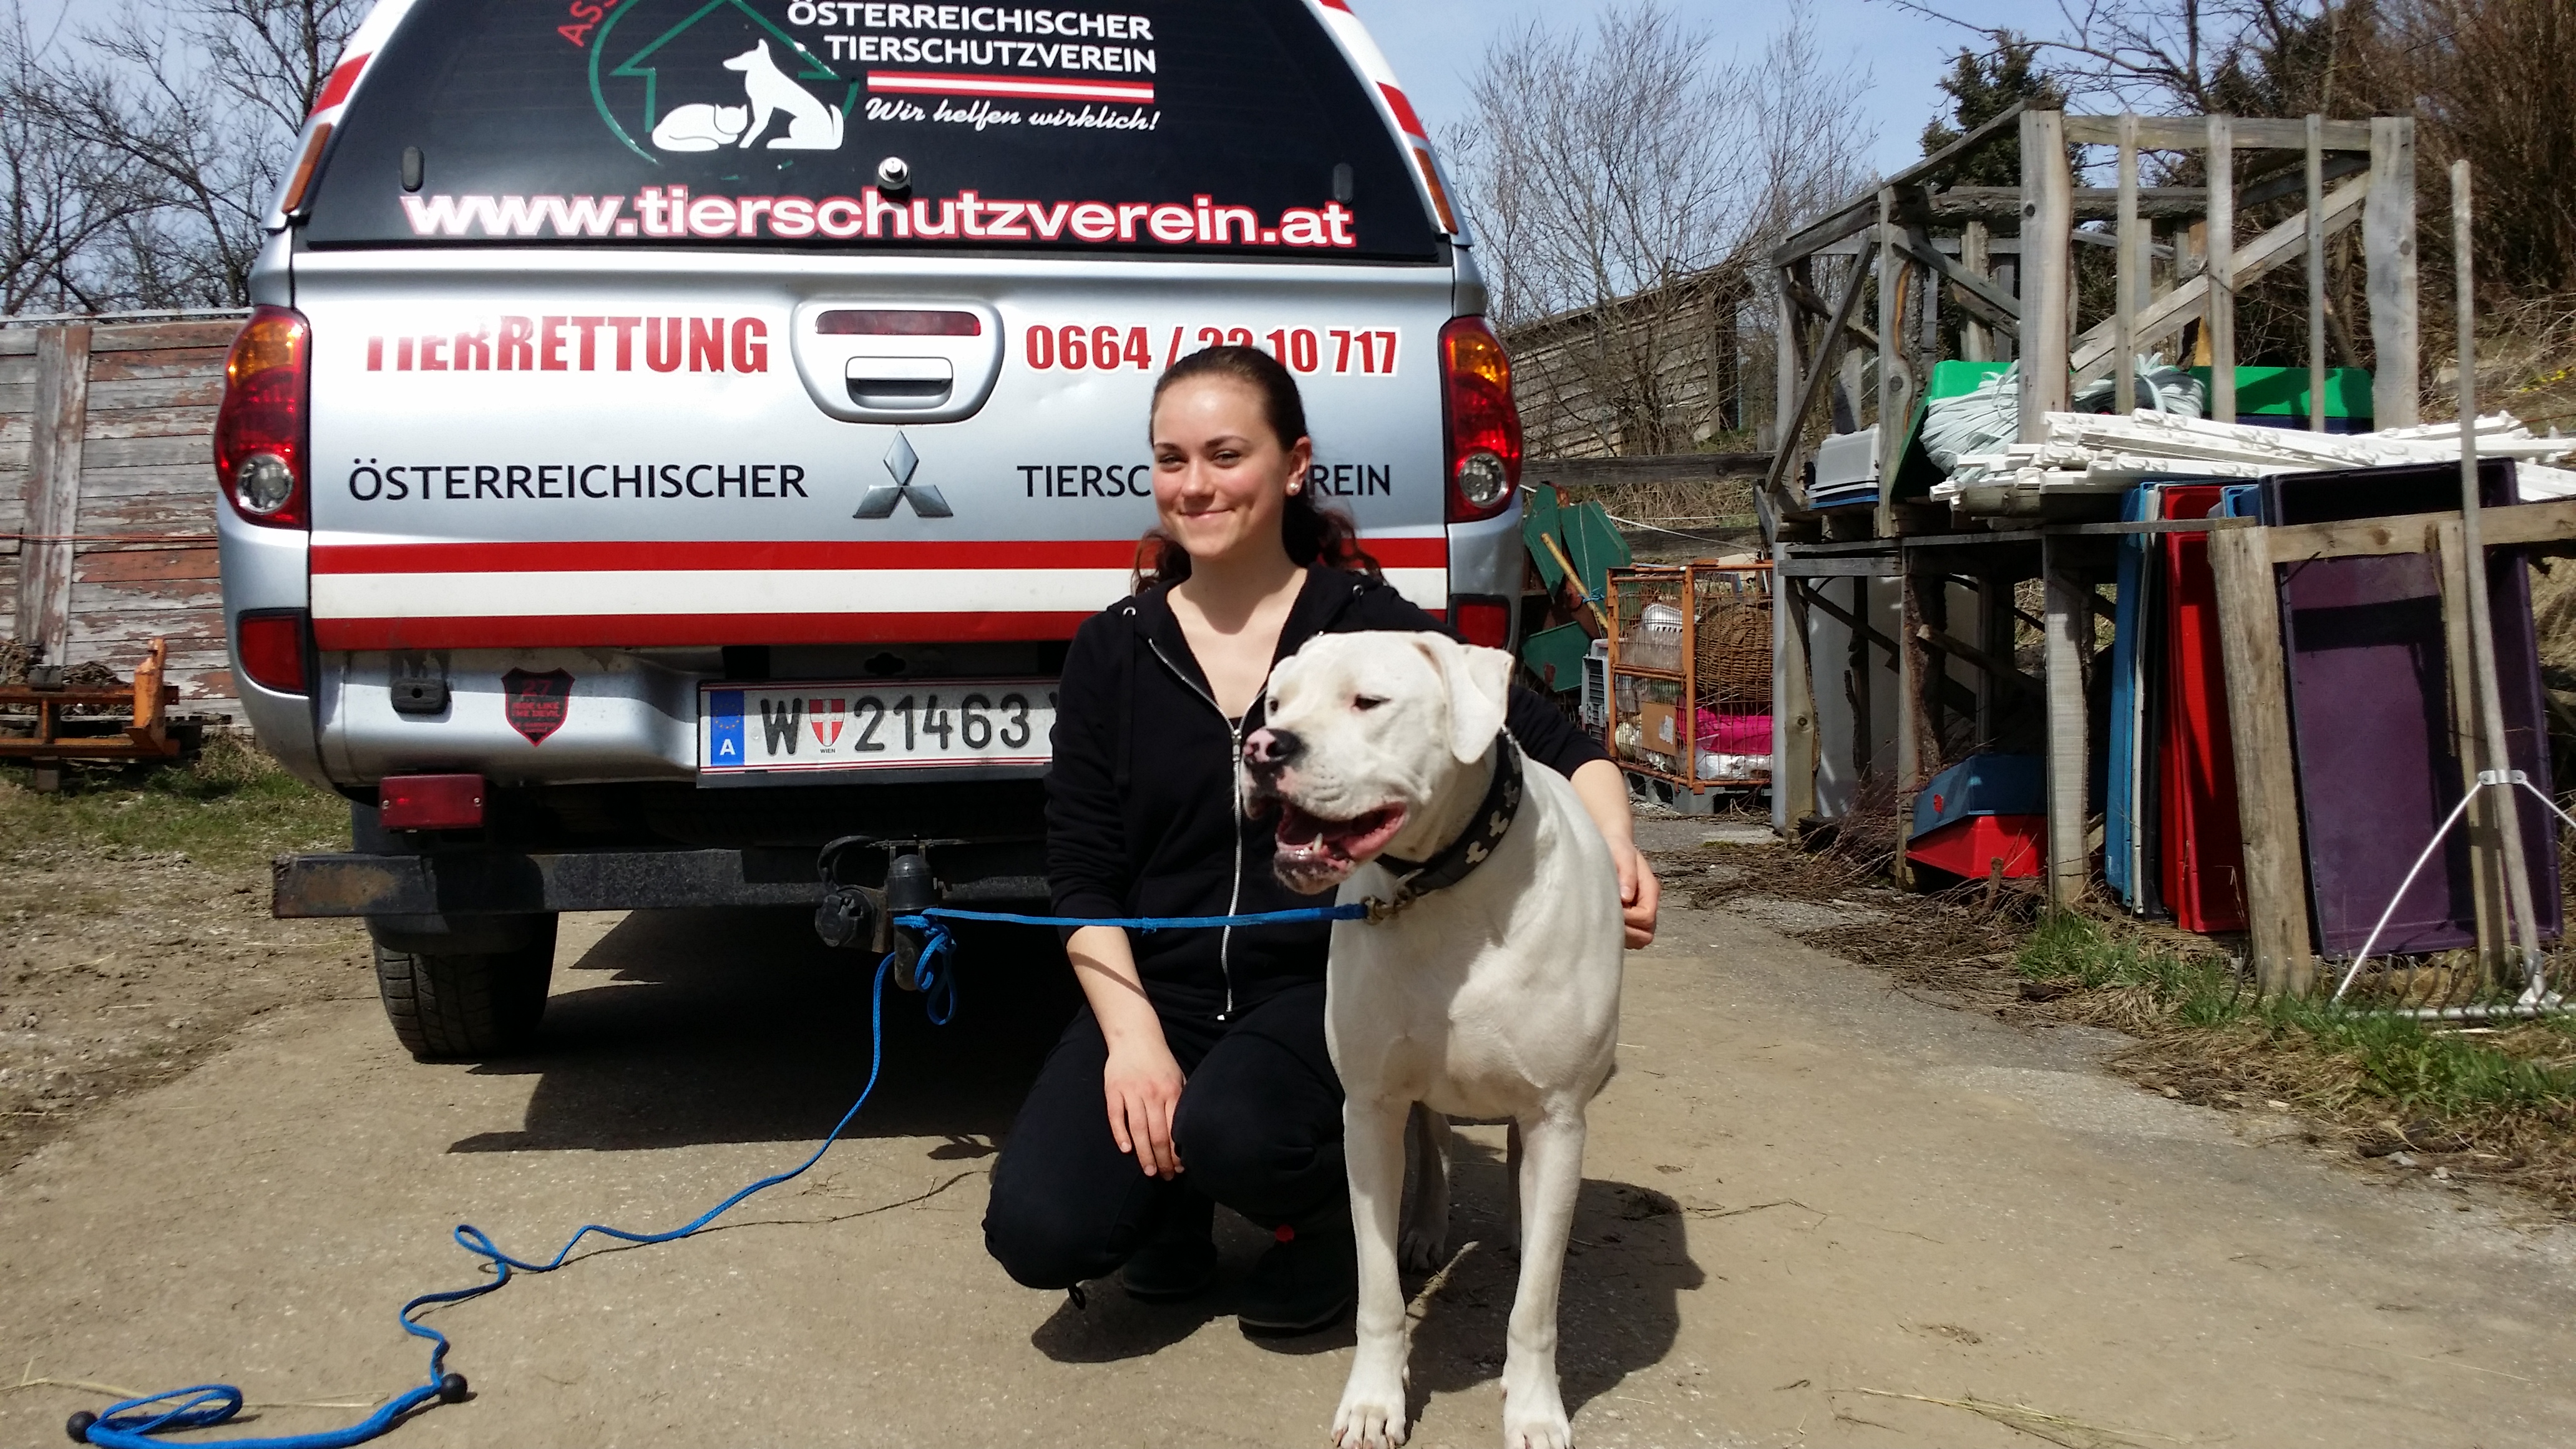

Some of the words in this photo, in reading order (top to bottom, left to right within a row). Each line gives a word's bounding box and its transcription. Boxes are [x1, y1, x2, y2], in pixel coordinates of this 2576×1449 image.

[788, 0, 1154, 41] ÖSTERREICHISCHER
[824, 35, 1156, 74] TIERSCHUTZVEREIN
[865, 97, 926, 121] Wir
[932, 99, 1022, 132] helfen
[1028, 104, 1161, 130] wirklich!
[400, 185, 1356, 248] www.tierschutzverein.at
[1027, 326, 1151, 370] 0664
[1266, 329, 1319, 373] 10
[1330, 330, 1397, 374] 717
[349, 458, 809, 501] ÖSTERREICHISCHER
[1017, 464, 1391, 497] TIERSCREIN
[522, 680, 553, 696] 27
[759, 697, 803, 756] W
[853, 692, 1031, 753] 21463
[719, 738, 736, 756] A
